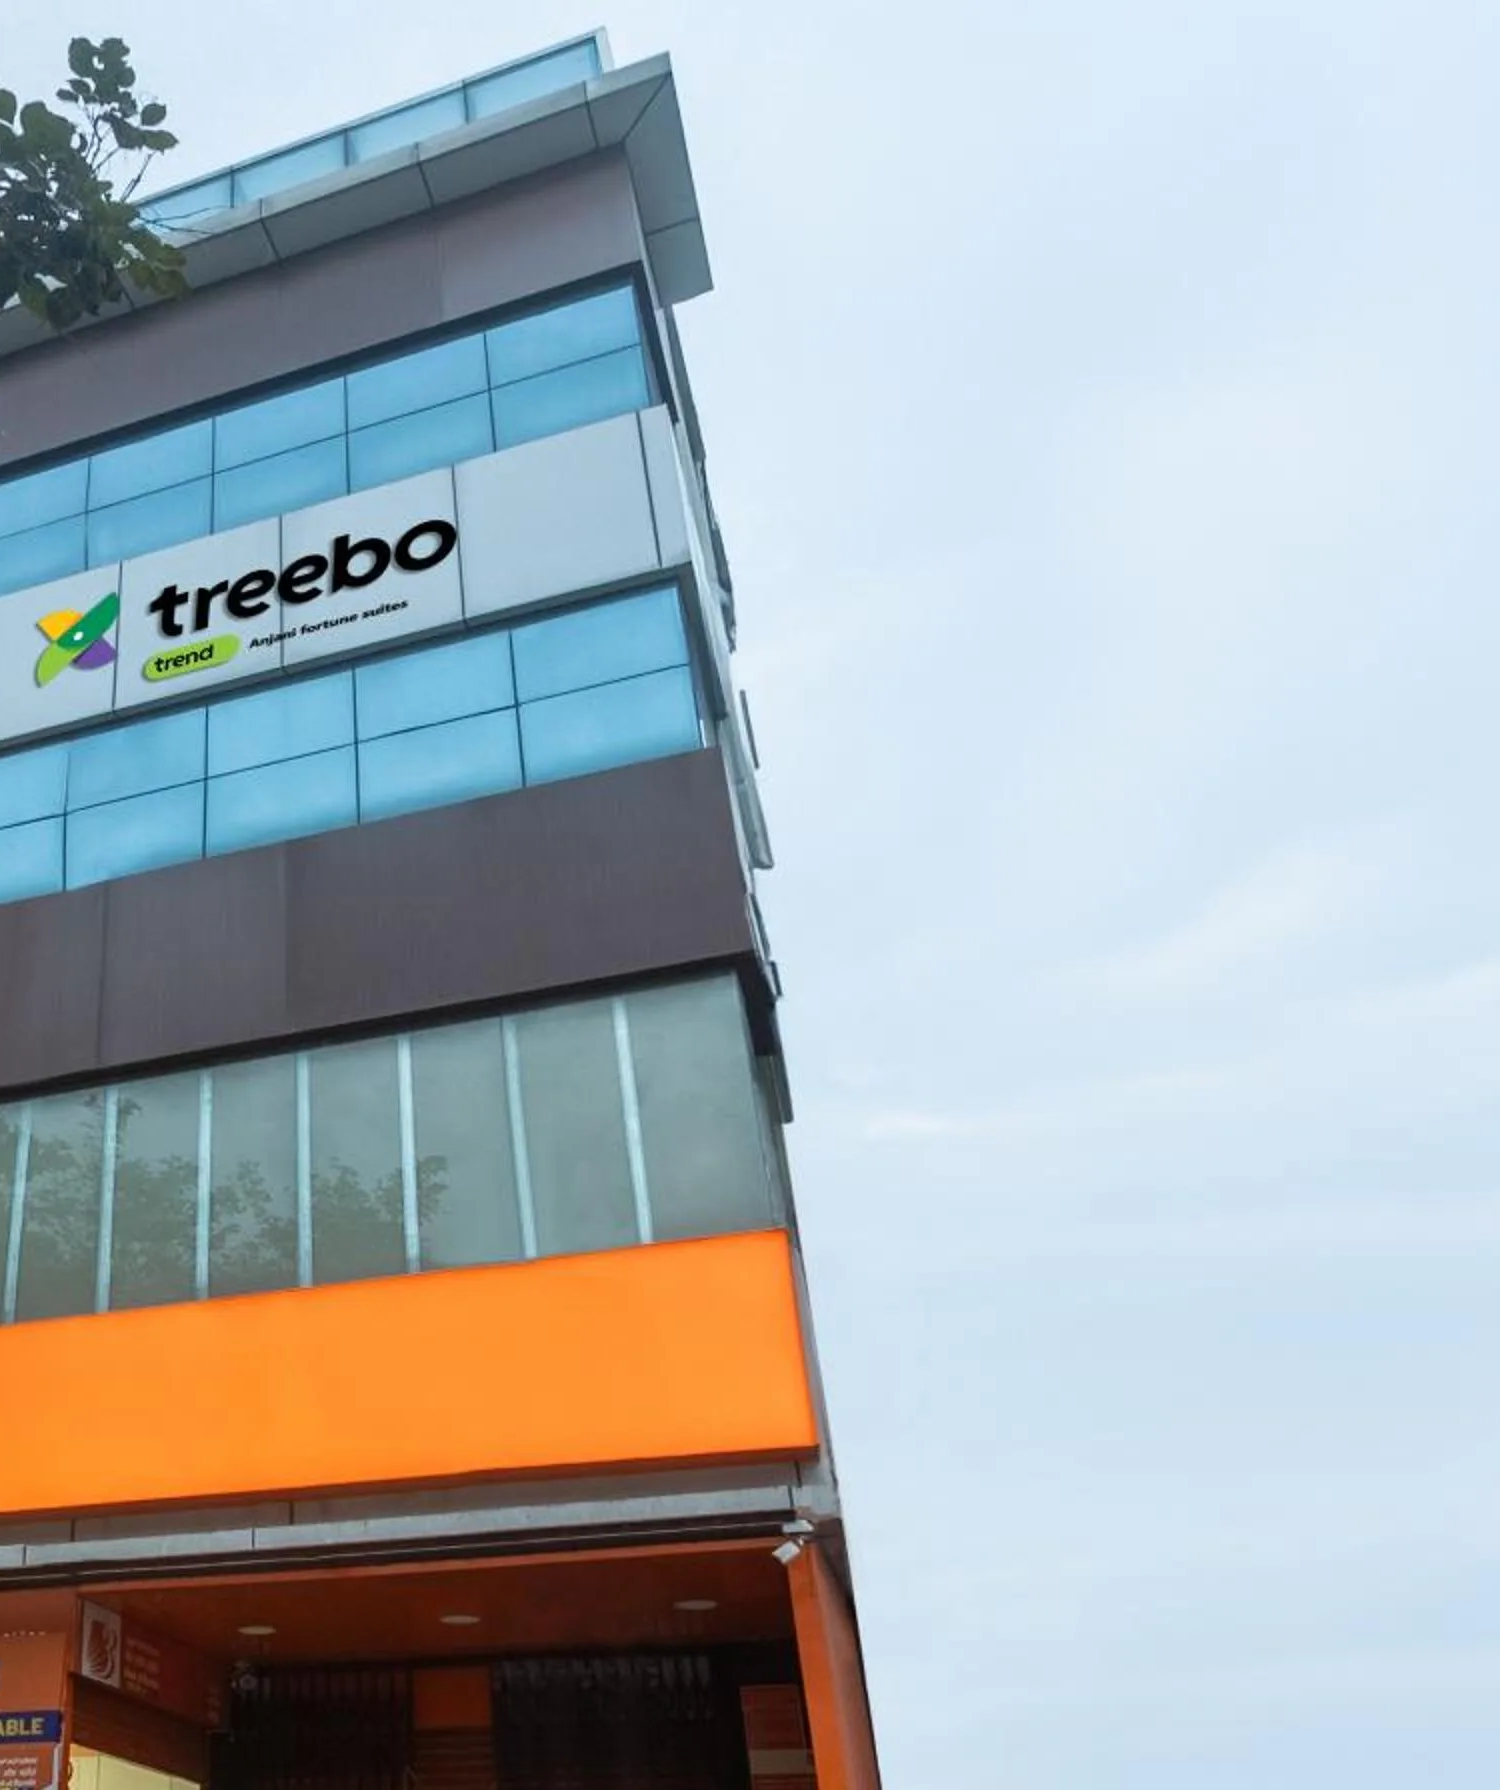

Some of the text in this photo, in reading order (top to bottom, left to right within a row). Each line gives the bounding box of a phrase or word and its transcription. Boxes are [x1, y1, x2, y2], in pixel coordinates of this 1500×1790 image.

[150, 520, 457, 637] treebo
[250, 600, 409, 649] Anjani fortune suites
[154, 643, 215, 673] trend
